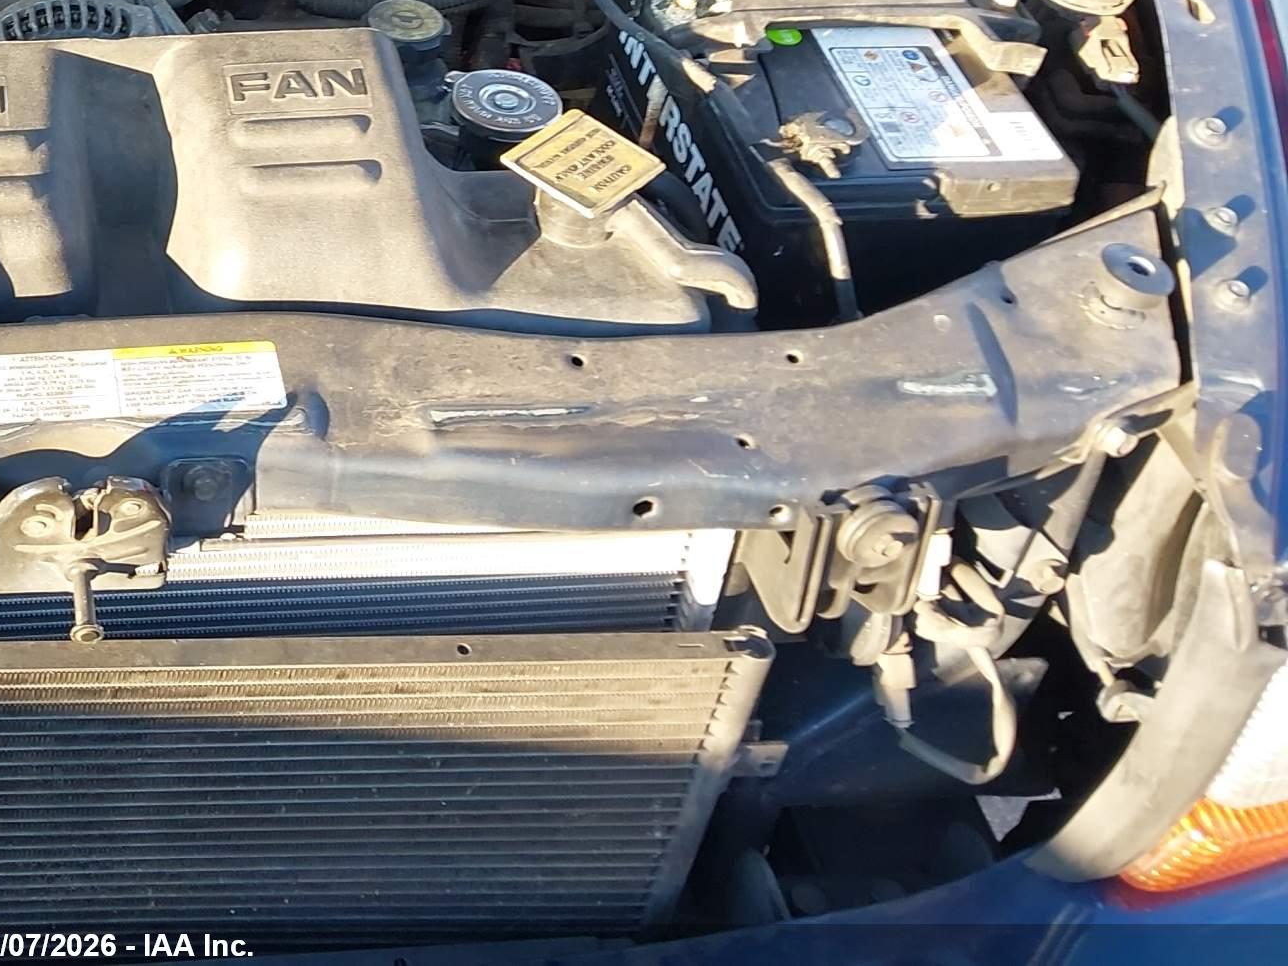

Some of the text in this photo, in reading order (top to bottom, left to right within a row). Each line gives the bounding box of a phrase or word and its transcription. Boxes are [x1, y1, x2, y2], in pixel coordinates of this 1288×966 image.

[230, 68, 367, 101] FAN
[593, 164, 632, 192] CAUTION
[180, 345, 224, 353] WARNING
